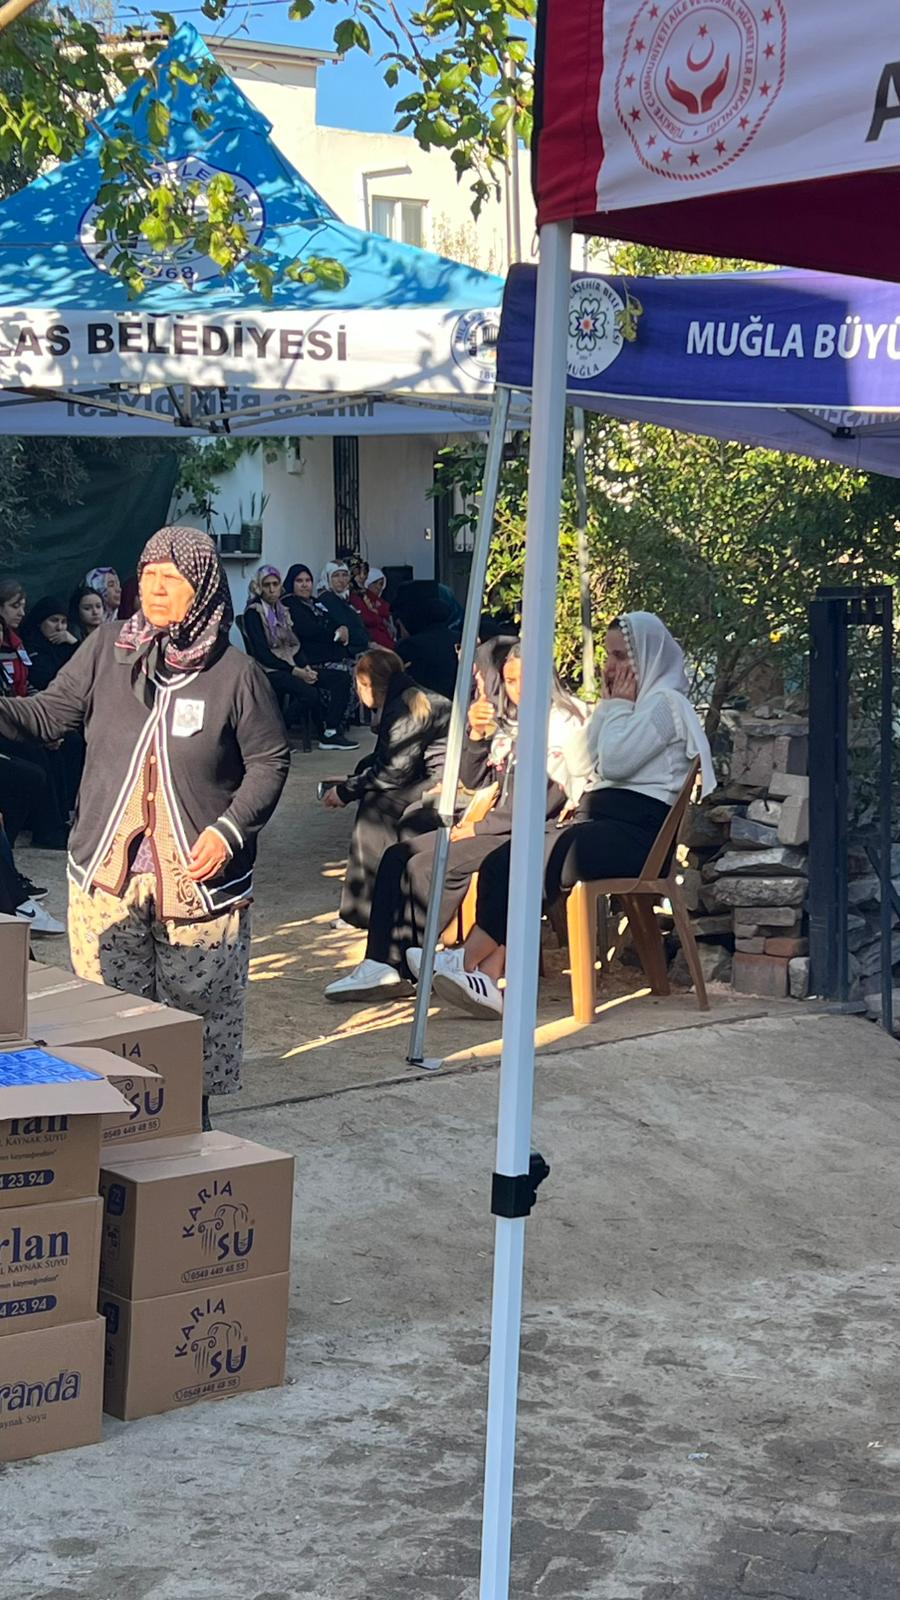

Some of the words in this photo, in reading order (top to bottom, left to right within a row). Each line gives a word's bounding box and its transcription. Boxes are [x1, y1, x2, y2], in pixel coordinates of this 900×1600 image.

[88, 321, 347, 361] BELEDİYESİ
[687, 315, 804, 358] MUĞLA
[128, 1087, 164, 1120] SU
[8, 1174, 24, 1188] 23
[28, 1172, 45, 1185] 94
[182, 1180, 233, 1238] KARIA
[217, 1228, 254, 1261] SU
[7, 1262, 42, 1274] KAYNAK
[45, 1258, 68, 1269] SUYU
[11, 1301, 27, 1315] 23
[31, 1298, 47, 1312] 94
[174, 1298, 226, 1357] KARIA
[209, 1345, 247, 1378] SU
